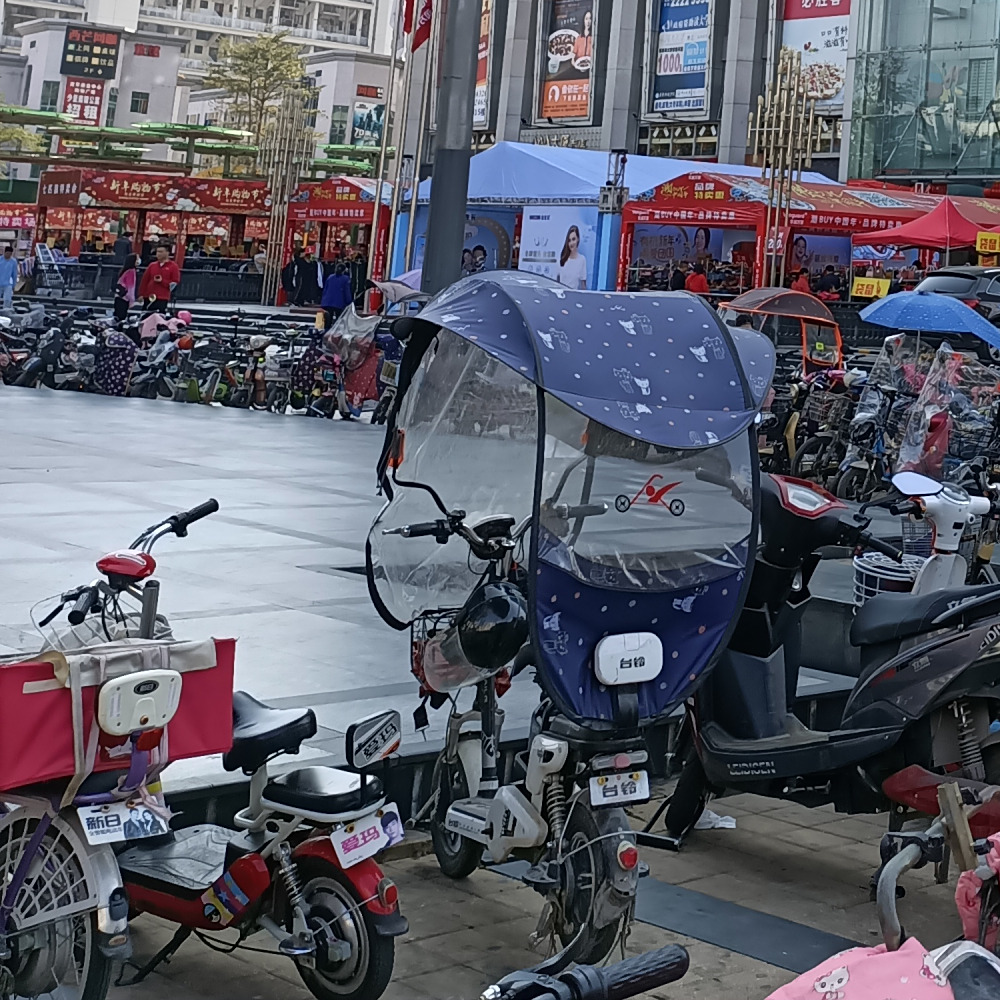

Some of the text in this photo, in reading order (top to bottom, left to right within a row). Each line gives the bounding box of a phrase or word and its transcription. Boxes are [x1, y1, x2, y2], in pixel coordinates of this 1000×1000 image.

[66, 103, 98, 120] 招租
[110, 179, 161, 194] 新年购物节
[212, 185, 260, 200] 新年购物节
[620, 656, 645, 669] 台铃
[363, 722, 398, 761] 爱玛
[602, 780, 637, 798] 台铃
[86, 814, 121, 830] 新日
[341, 825, 380, 855] 爱玛
